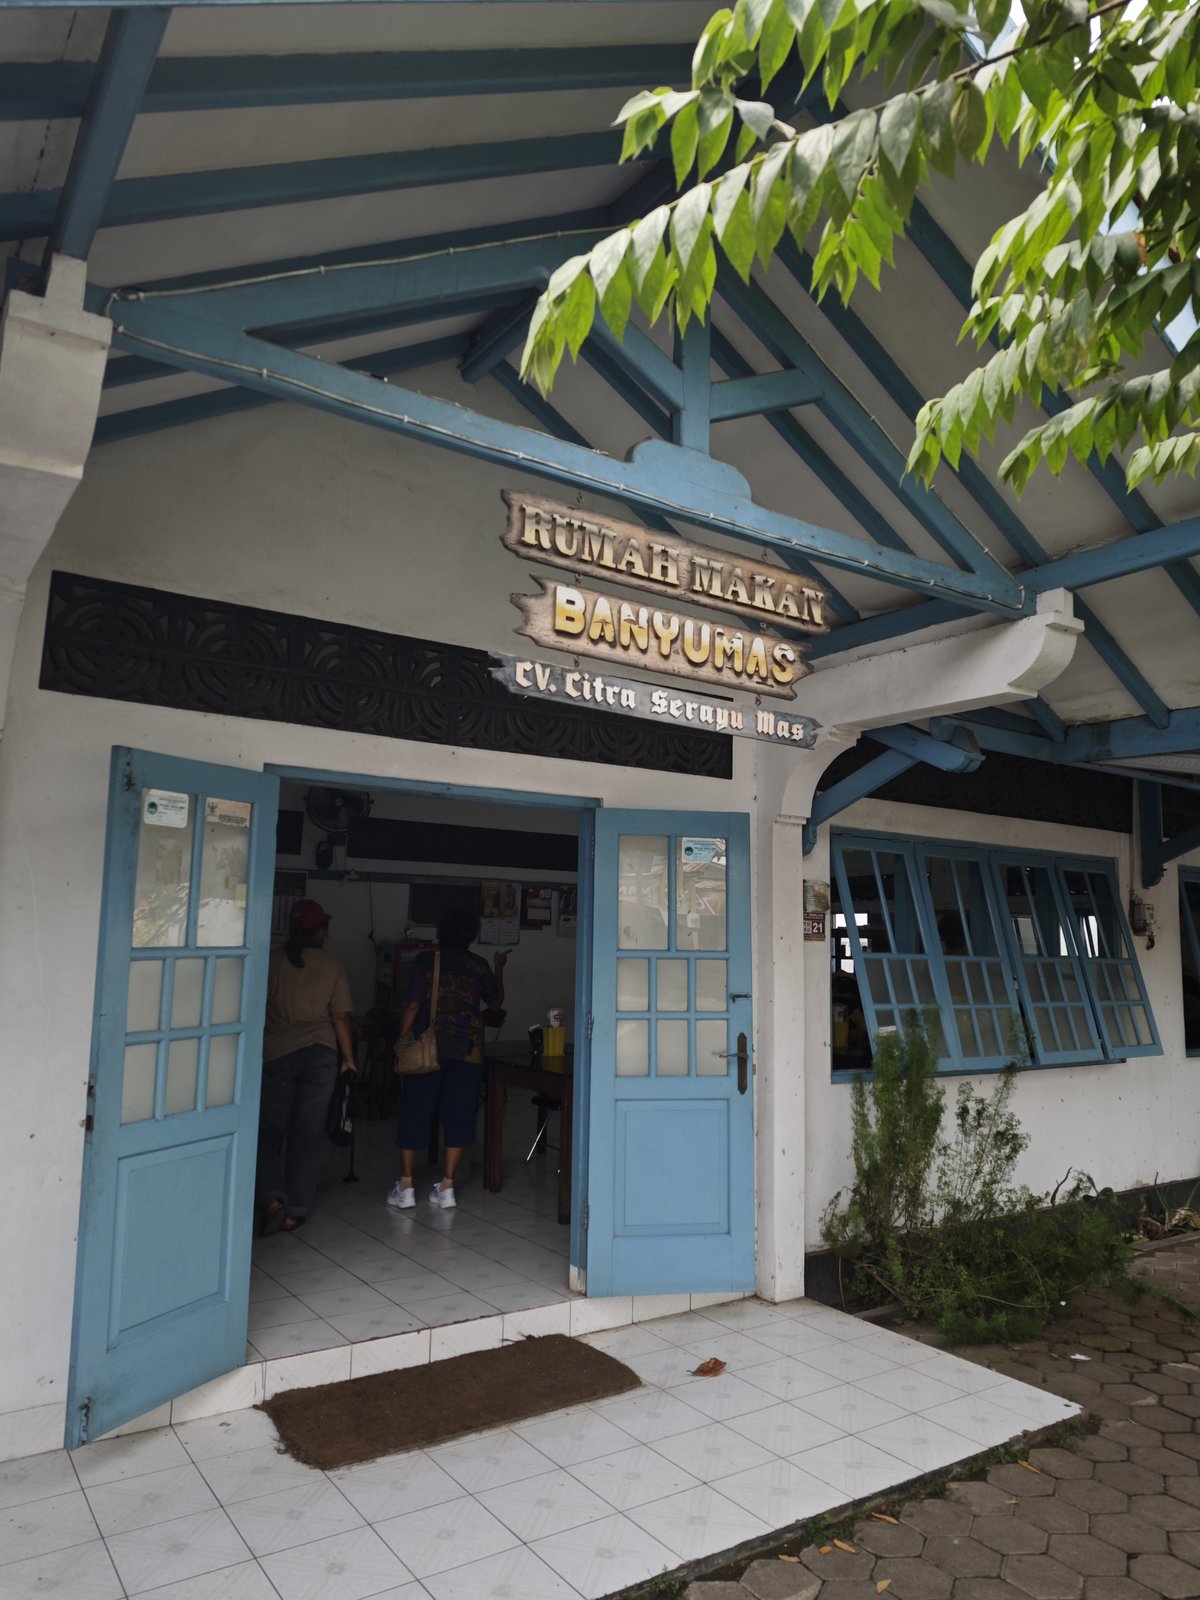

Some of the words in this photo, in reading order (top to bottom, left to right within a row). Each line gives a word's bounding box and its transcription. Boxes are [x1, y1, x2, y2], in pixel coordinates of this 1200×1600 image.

[521, 503, 680, 586] RUMAH
[692, 555, 825, 625] MAKAN
[553, 585, 795, 683] BANYUMAS
[515, 661, 557, 693] CV.
[565, 671, 637, 710] Citra
[651, 689, 744, 731] Serayu
[756, 709, 804, 741] Mas
[812, 922, 823, 933] 21
